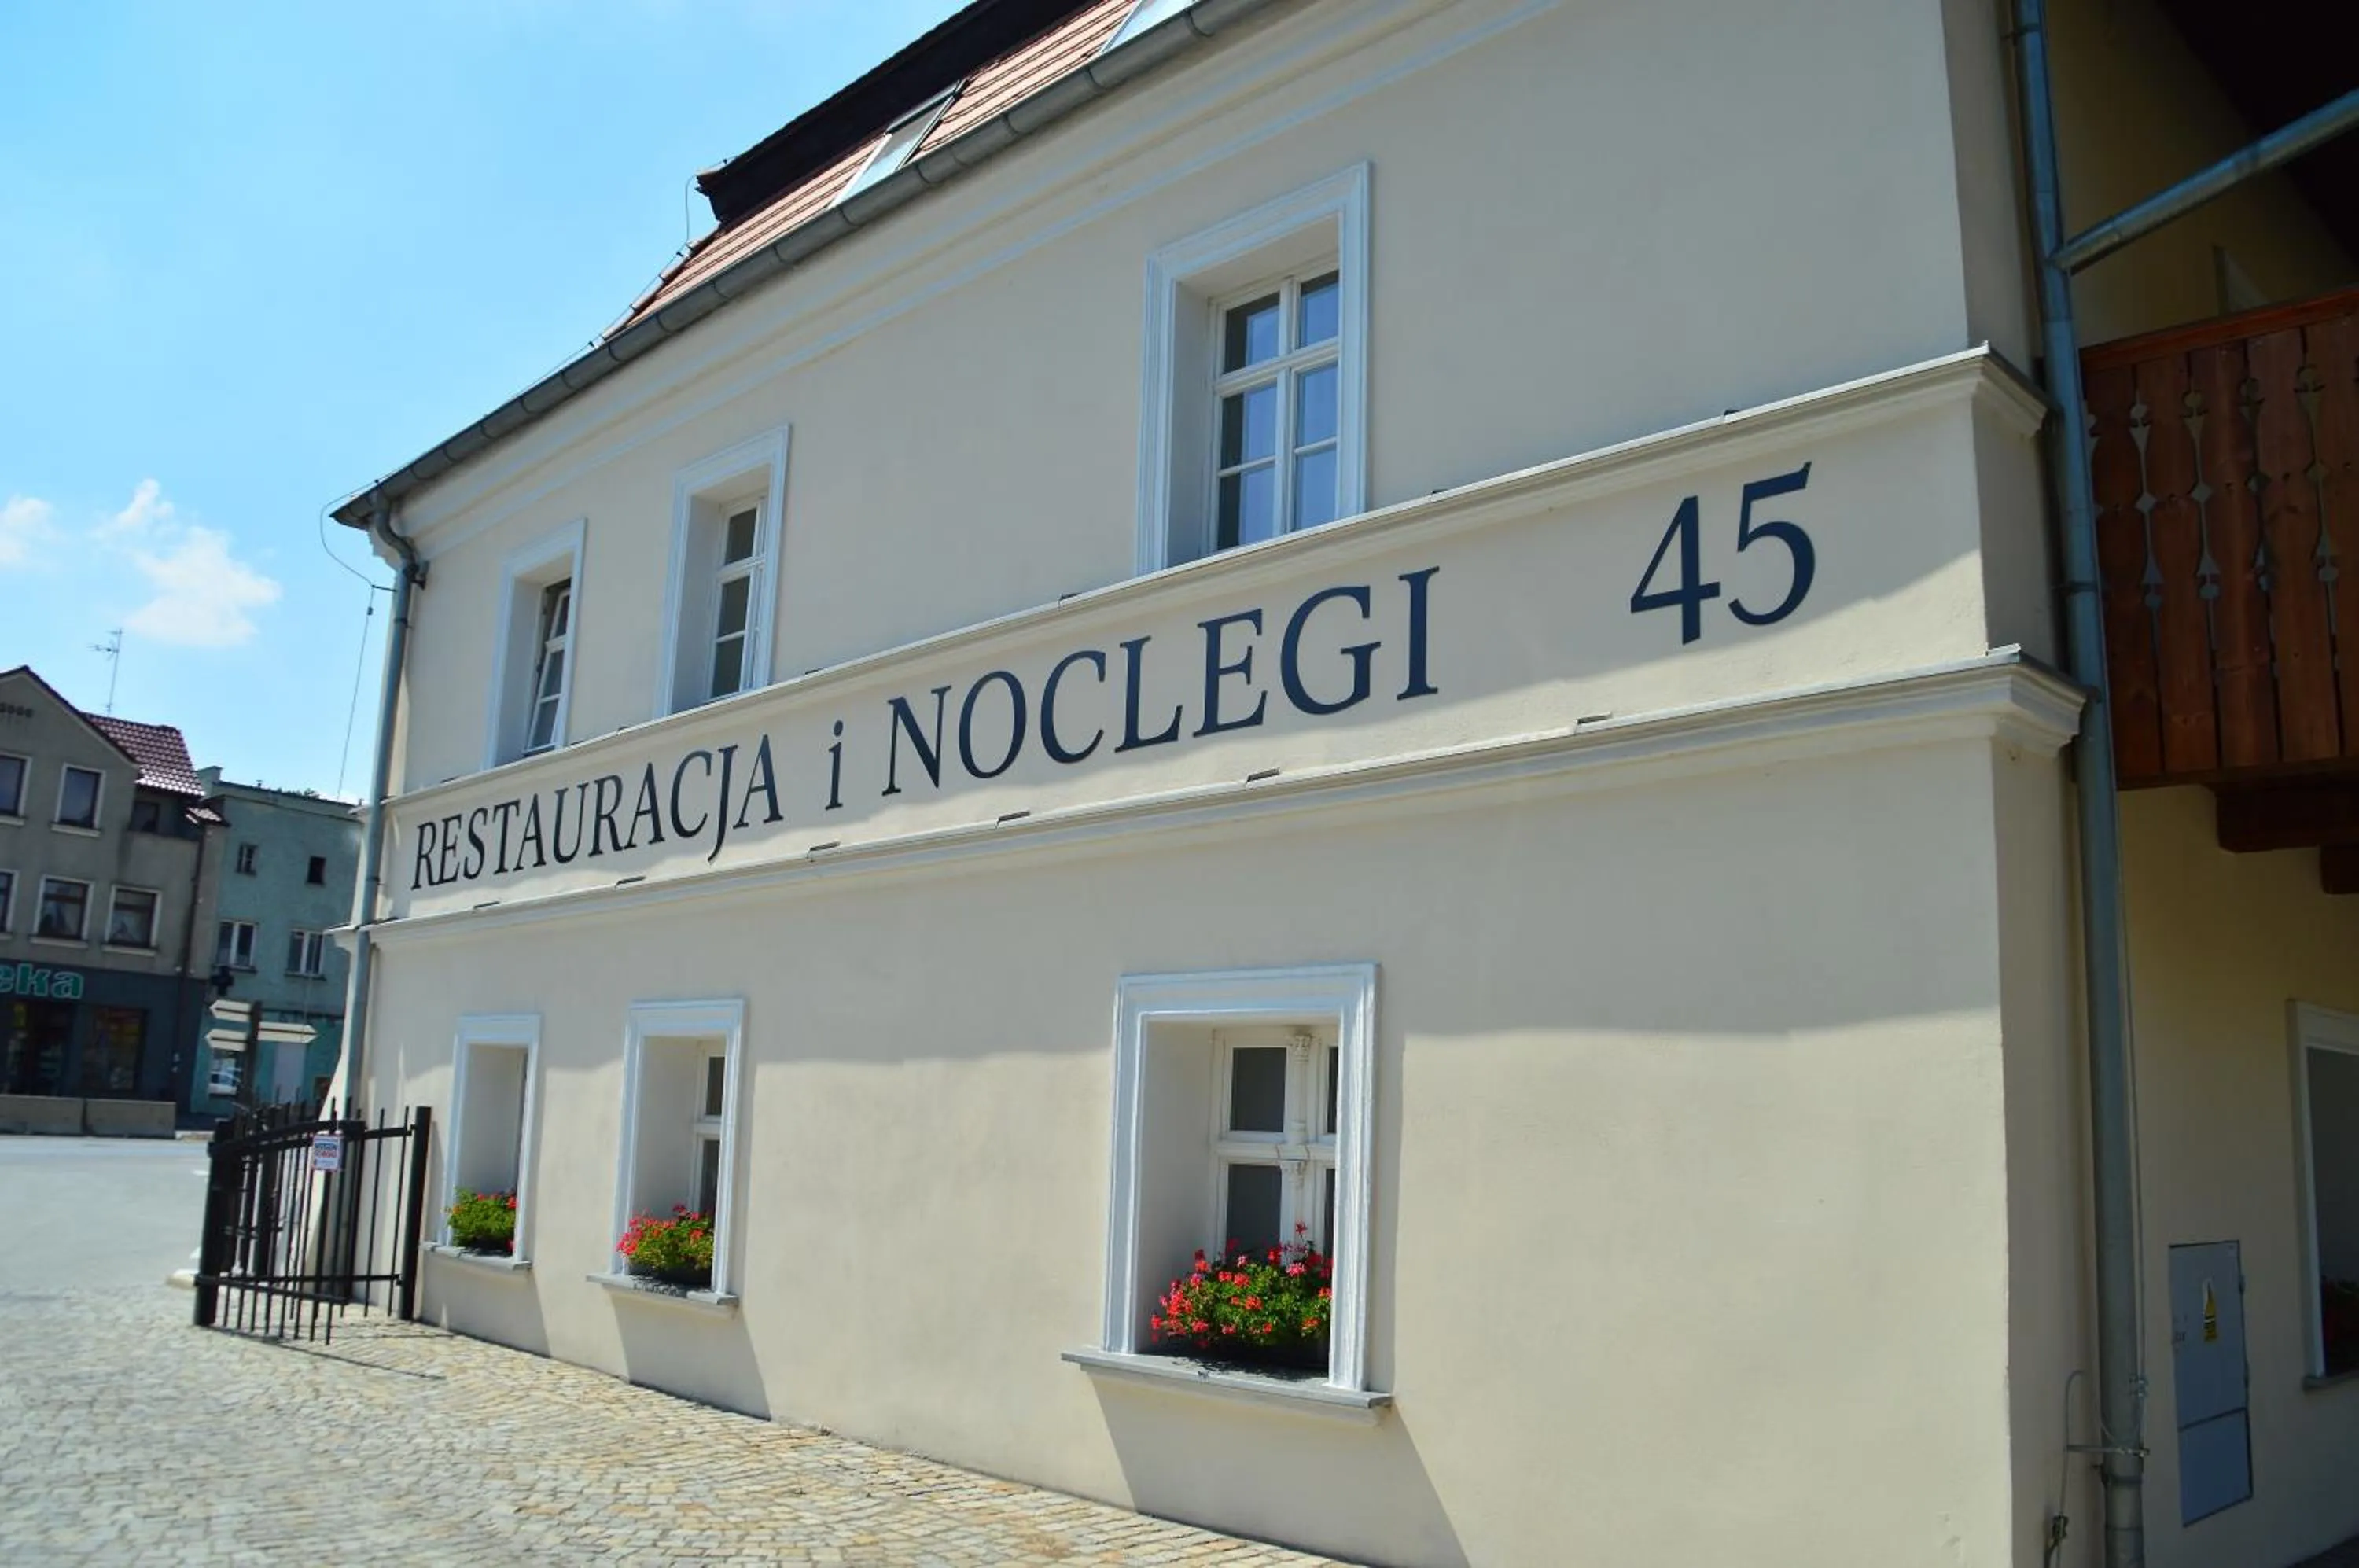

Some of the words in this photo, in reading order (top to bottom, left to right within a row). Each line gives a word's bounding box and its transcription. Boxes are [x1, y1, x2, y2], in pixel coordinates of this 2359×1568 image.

[410, 733, 785, 891] RESTAURACJA
[824, 720, 844, 811] i
[881, 565, 1441, 797] NOCLEGI
[1630, 461, 1816, 645] 45
